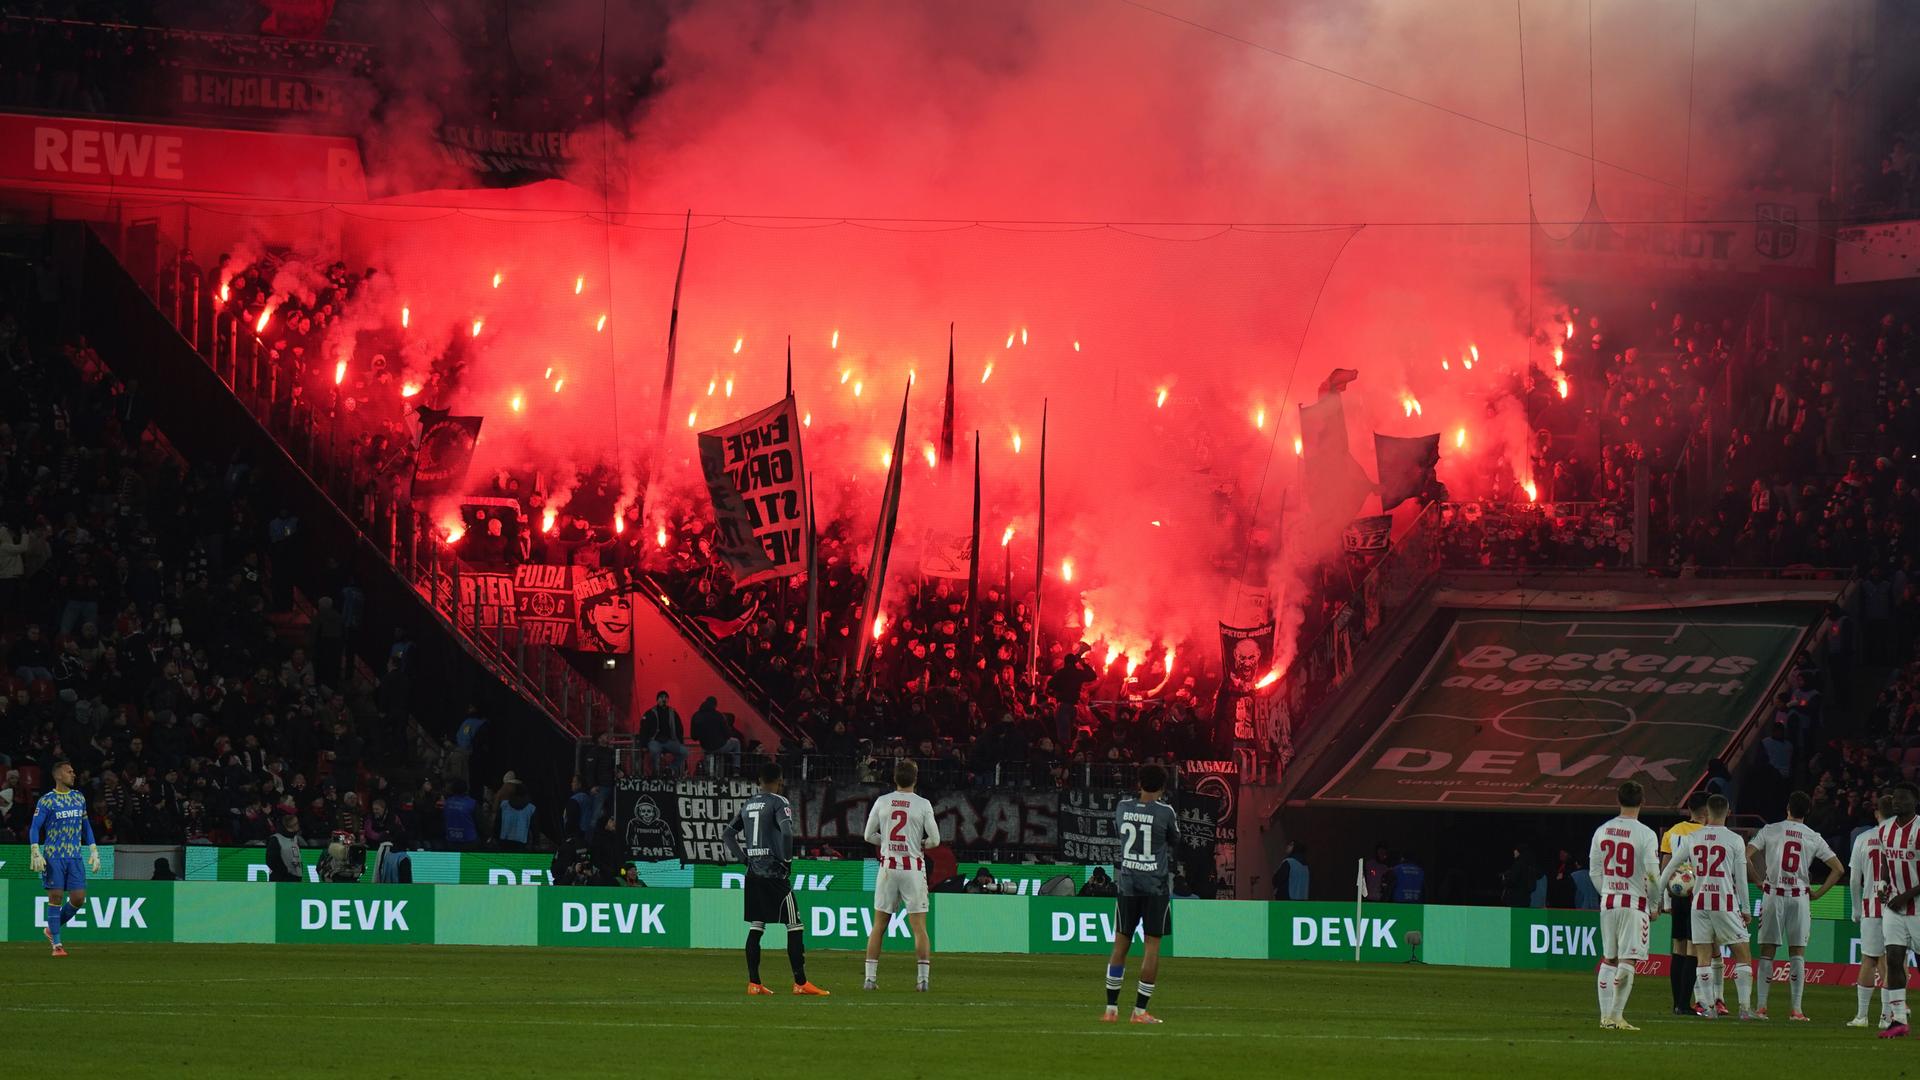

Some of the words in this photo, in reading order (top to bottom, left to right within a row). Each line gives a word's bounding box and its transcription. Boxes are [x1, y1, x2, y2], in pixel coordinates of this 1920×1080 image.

[34, 127, 184, 180] REWE
[515, 564, 566, 588] FULDA
[520, 597, 528, 611] 3
[557, 600, 565, 613] 6
[522, 621, 569, 645] CREW
[1457, 645, 1759, 674] Bestens
[1441, 674, 1744, 696] abgesichert
[1372, 748, 1692, 782] DEVK
[55, 810, 79, 819] REWE
[748, 811, 760, 846] 7
[890, 810, 908, 842] 2
[1123, 812, 1154, 823] BROWN
[1120, 823, 1156, 862] 21
[1600, 839, 1635, 878] 29
[1781, 841, 1802, 873] 6
[1885, 849, 1904, 859] EWE
[1693, 844, 1726, 877] 32
[301, 899, 409, 931] DEVK
[562, 902, 666, 934] DEVK
[1292, 917, 1398, 948] DEVK
[1530, 924, 1597, 956] DEVK
